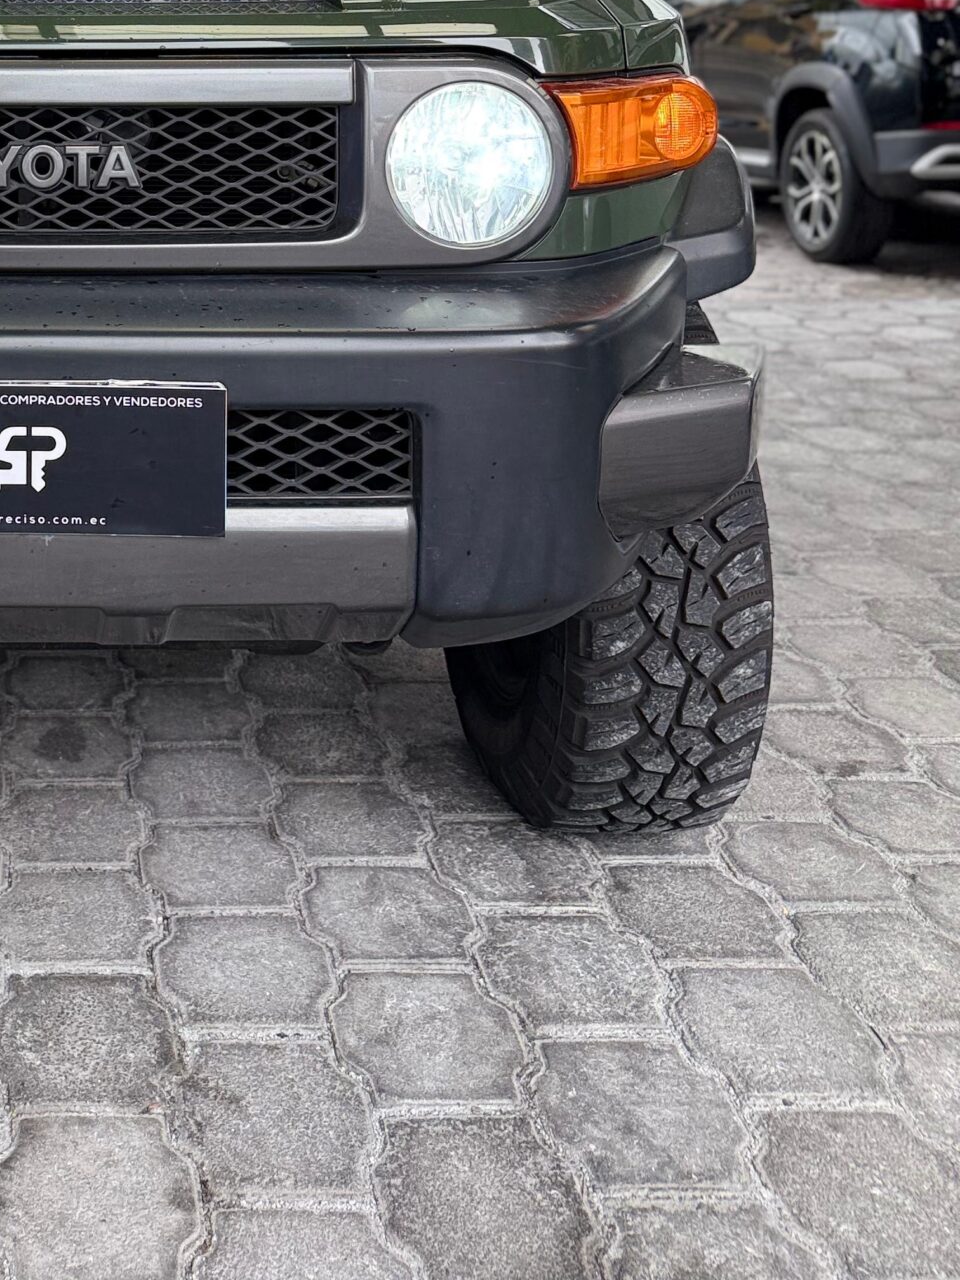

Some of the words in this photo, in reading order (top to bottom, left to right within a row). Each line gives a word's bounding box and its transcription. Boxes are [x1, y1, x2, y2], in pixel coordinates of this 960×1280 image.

[0, 394, 101, 407] COMPRADORES
[103, 396, 112, 407] Y
[114, 396, 203, 409] VENDEDORES
